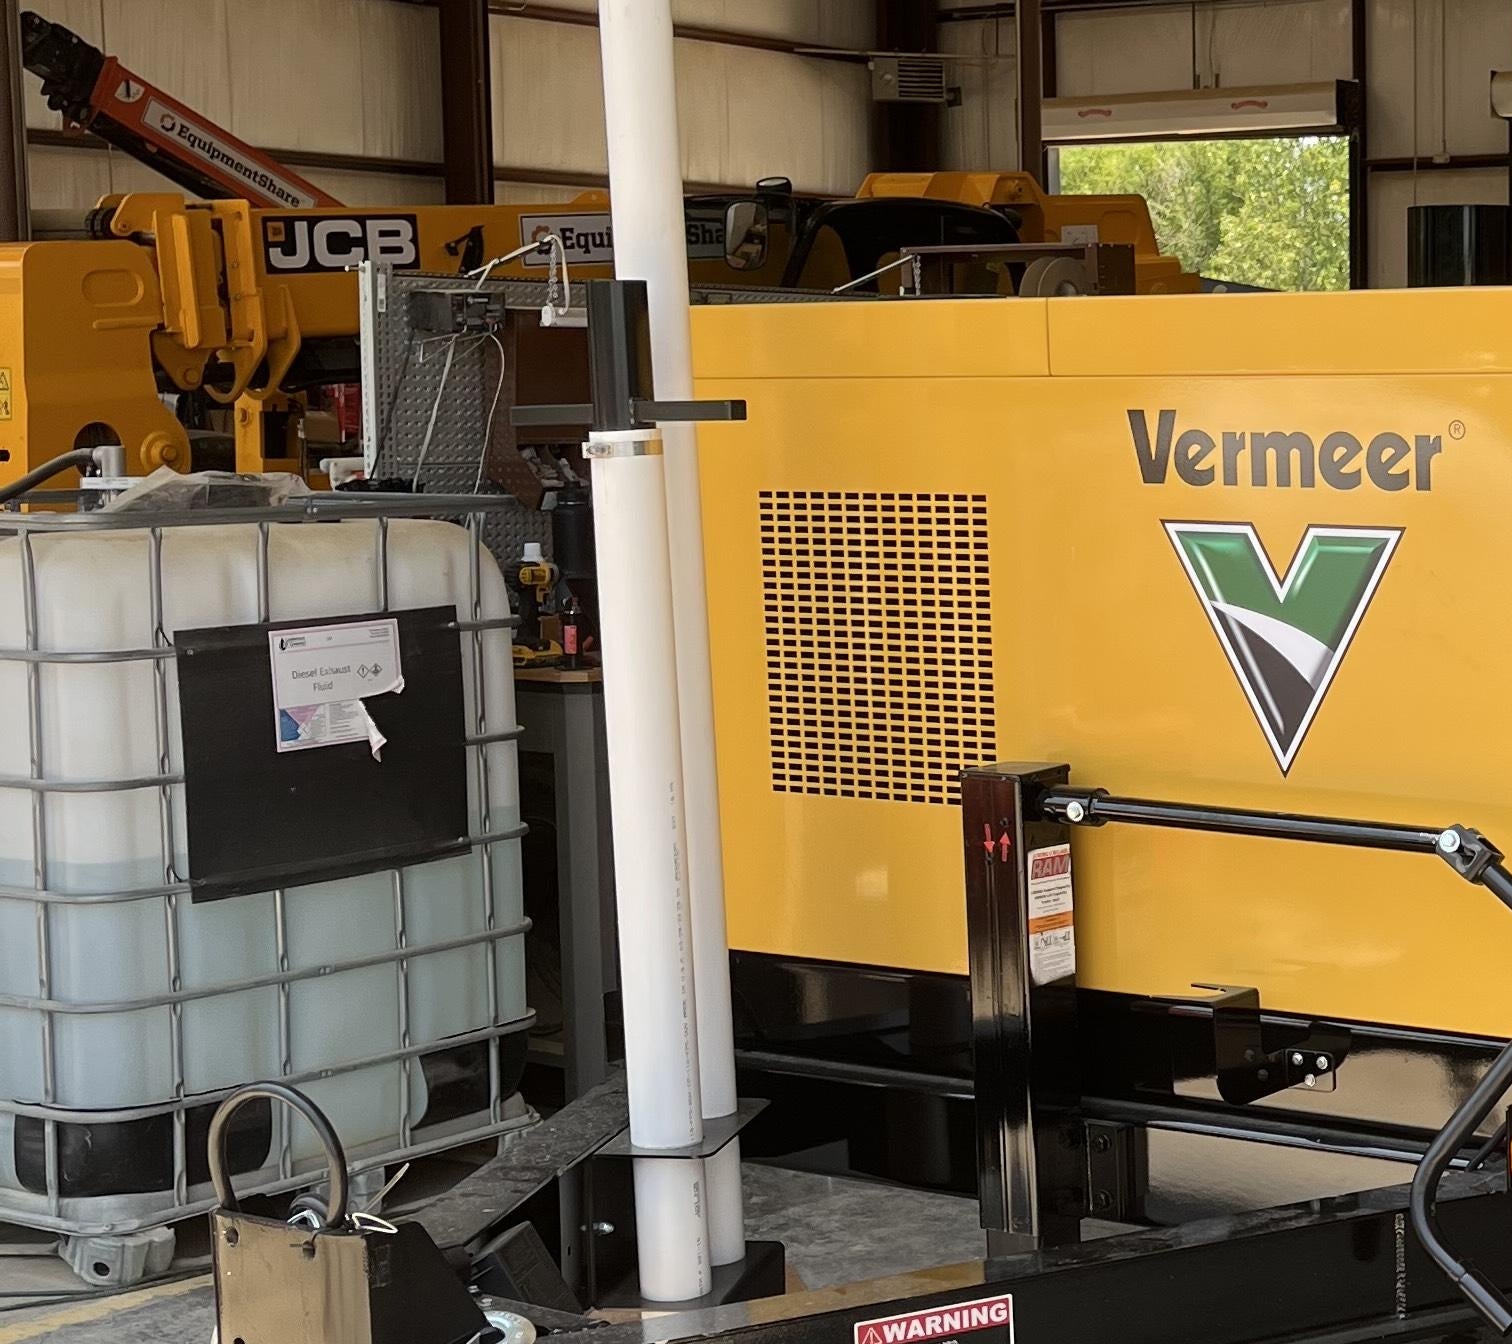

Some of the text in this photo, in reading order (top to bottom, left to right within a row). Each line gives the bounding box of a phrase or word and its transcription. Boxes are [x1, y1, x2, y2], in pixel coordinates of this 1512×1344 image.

[177, 124, 300, 207] EquipmentShare
[268, 218, 416, 268] JCB
[1127, 409, 1443, 491] Vermeer
[1032, 856, 1070, 879] RAM
[882, 1303, 1008, 1343] WARNING
